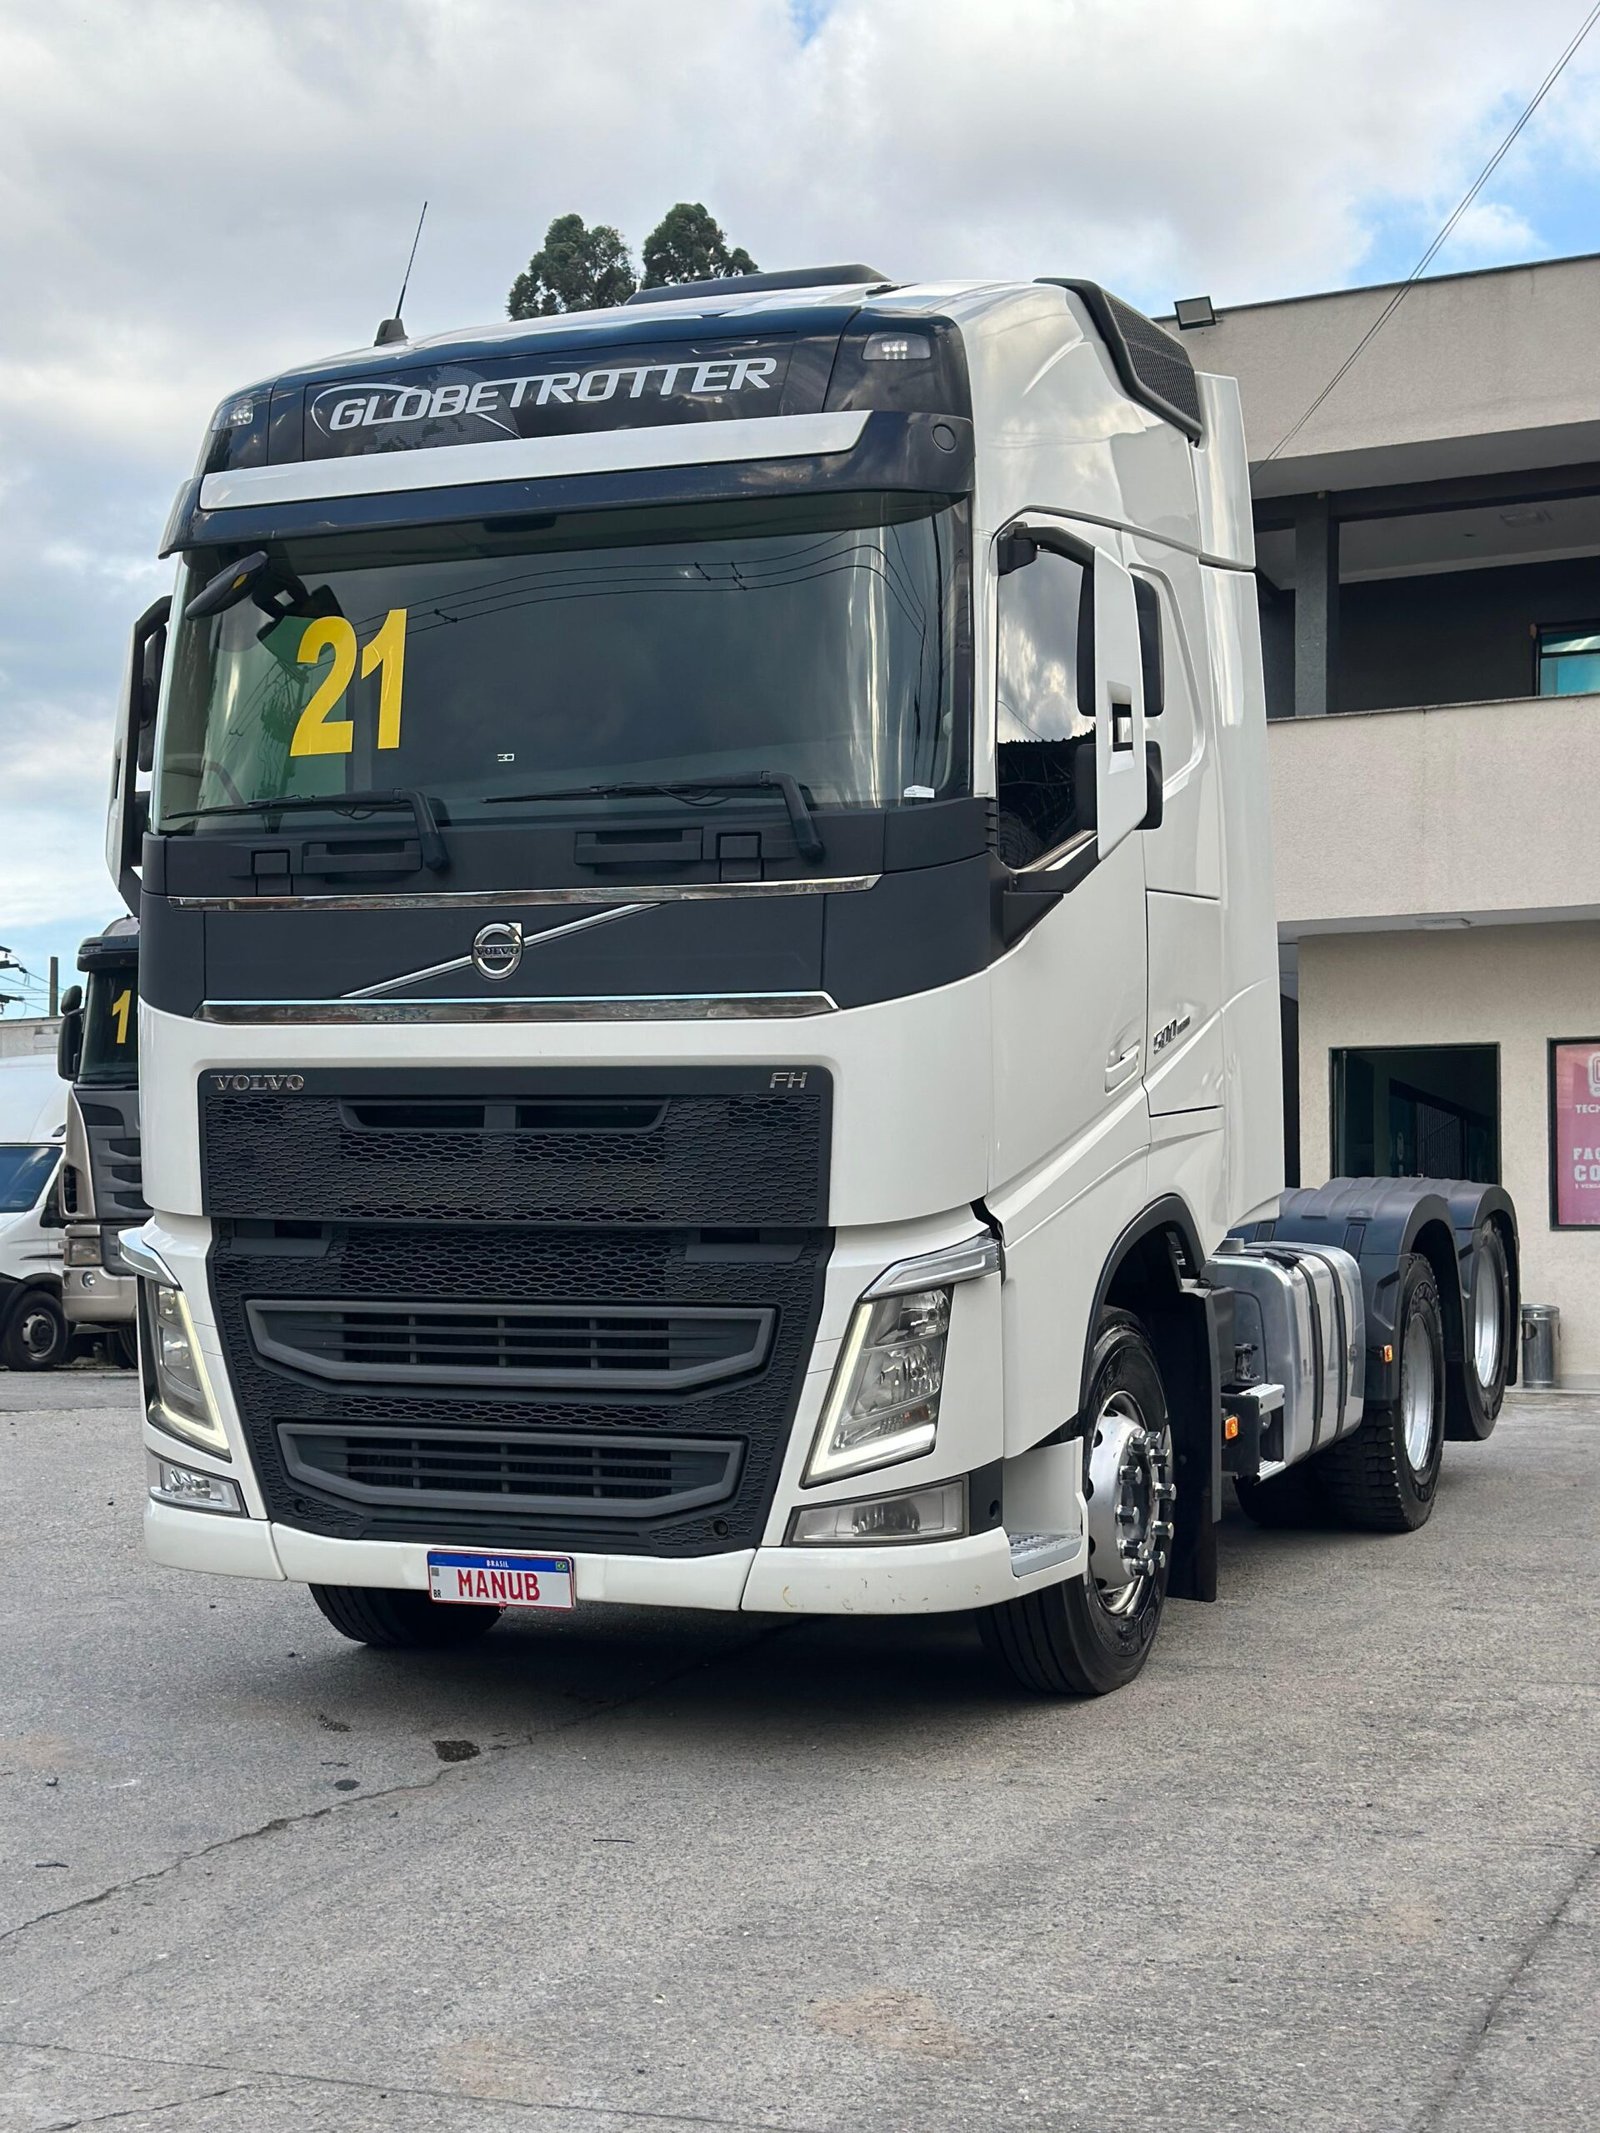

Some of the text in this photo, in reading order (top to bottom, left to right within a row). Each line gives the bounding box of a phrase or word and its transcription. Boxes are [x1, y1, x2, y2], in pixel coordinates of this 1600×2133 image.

[329, 357, 777, 431] GLOBETROTTER
[290, 608, 407, 757] 21
[476, 946, 519, 955] VOLVO
[210, 1074, 304, 1091] VOLVO
[770, 1072, 807, 1088] FH
[486, 1560, 510, 1568] BRASIL
[457, 1569, 540, 1601] MANUB
[433, 1589, 442, 1598] BR
